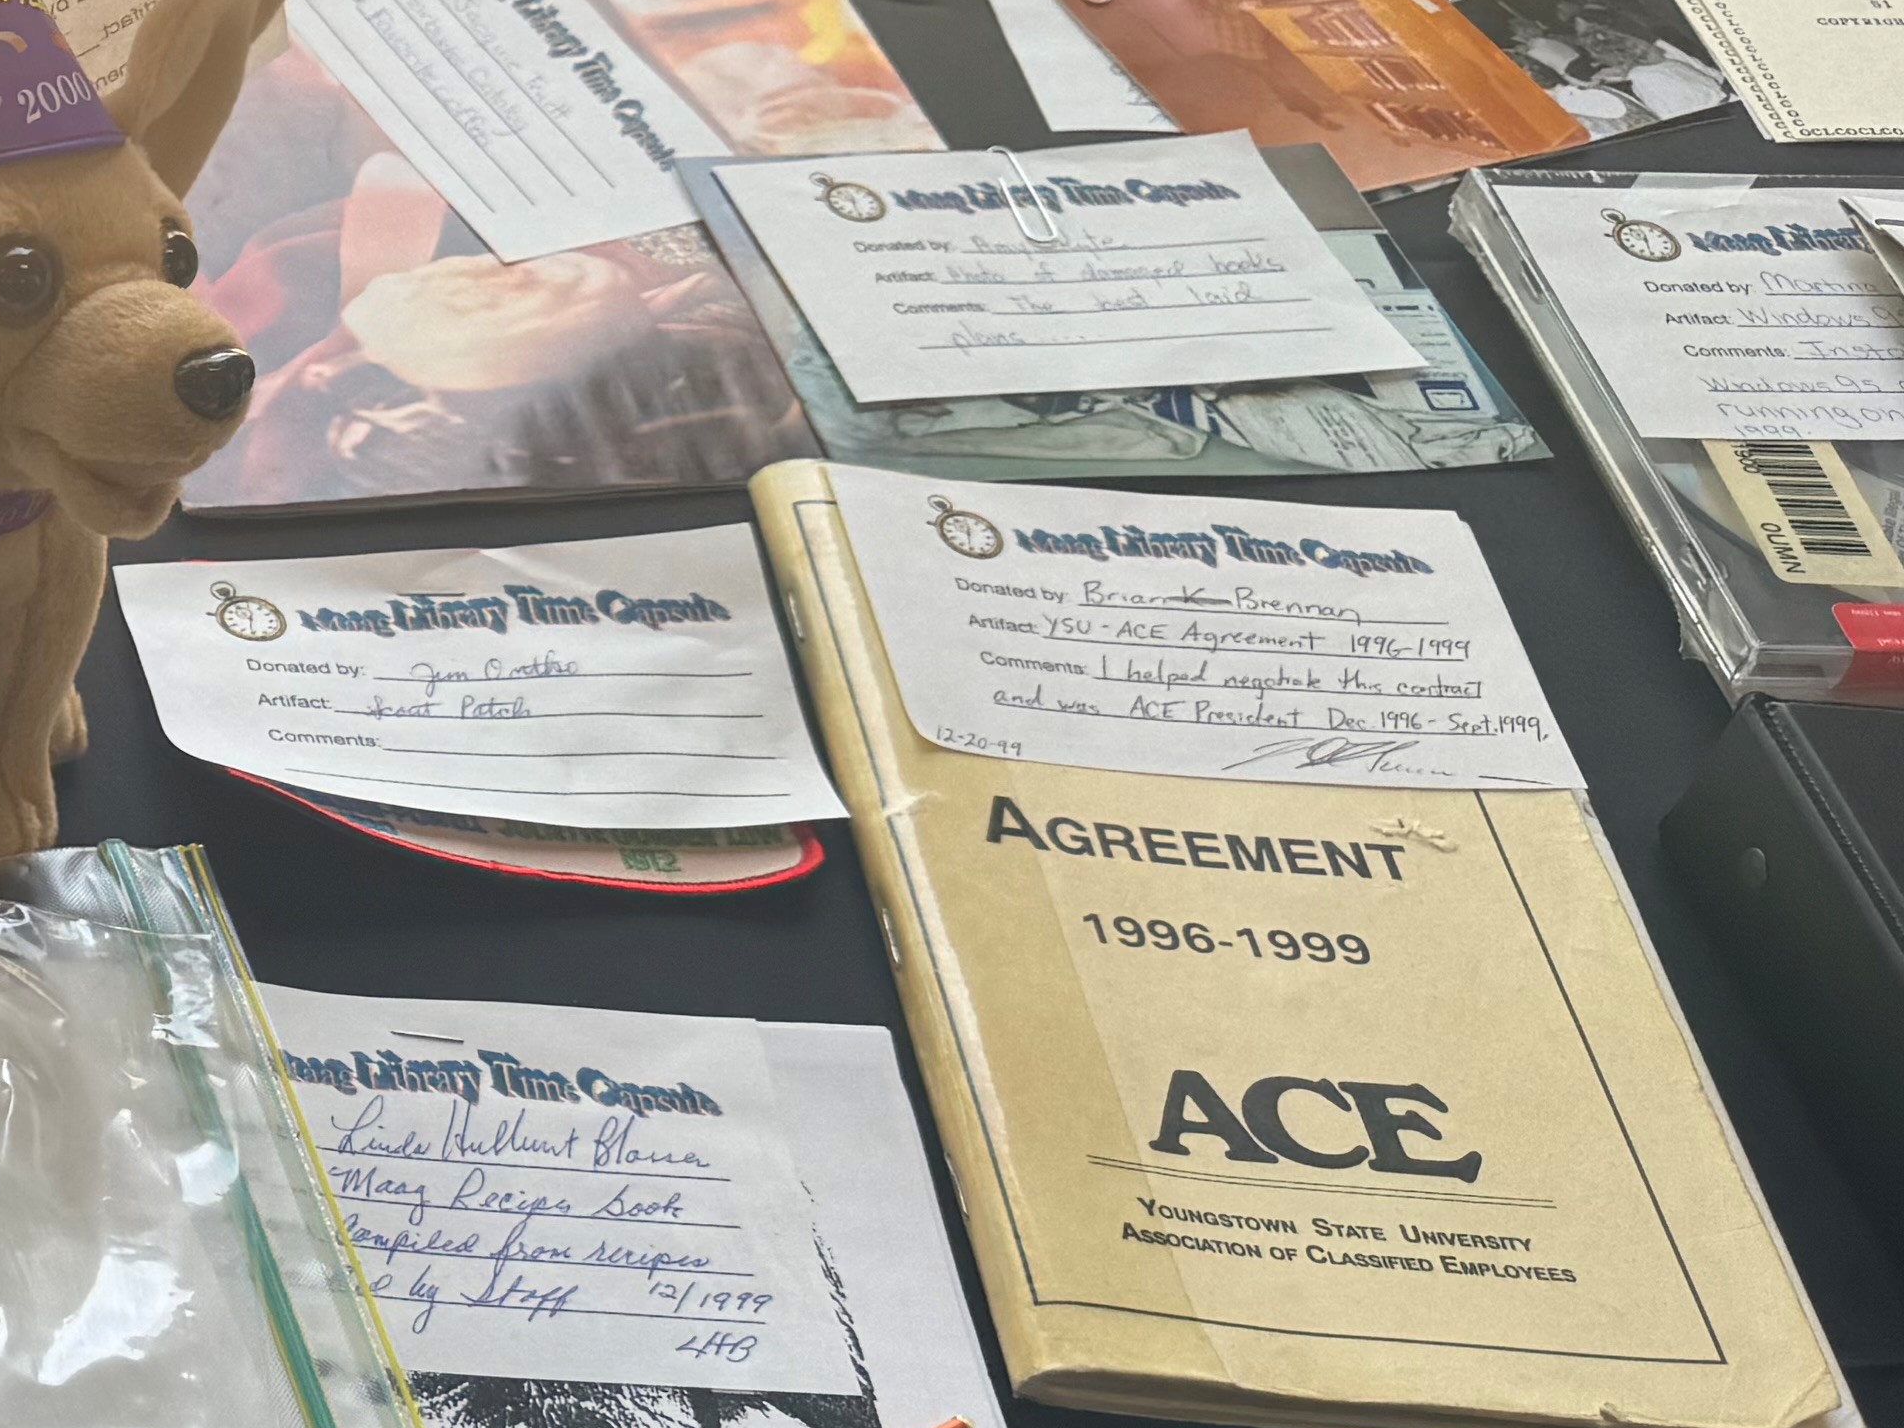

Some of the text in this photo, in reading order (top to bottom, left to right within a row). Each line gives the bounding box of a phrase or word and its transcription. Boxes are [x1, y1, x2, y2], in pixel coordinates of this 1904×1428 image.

[20, 66, 92, 123] 2000
[1234, 586, 1362, 625] Brennan
[246, 658, 365, 678] Donated by:
[258, 693, 332, 709] Artifact:
[268, 729, 380, 747] Comments:
[936, 727, 1021, 756] 12-20-99
[1083, 913, 1370, 964] 1996-1999
[1148, 1068, 1483, 1184] ACE
